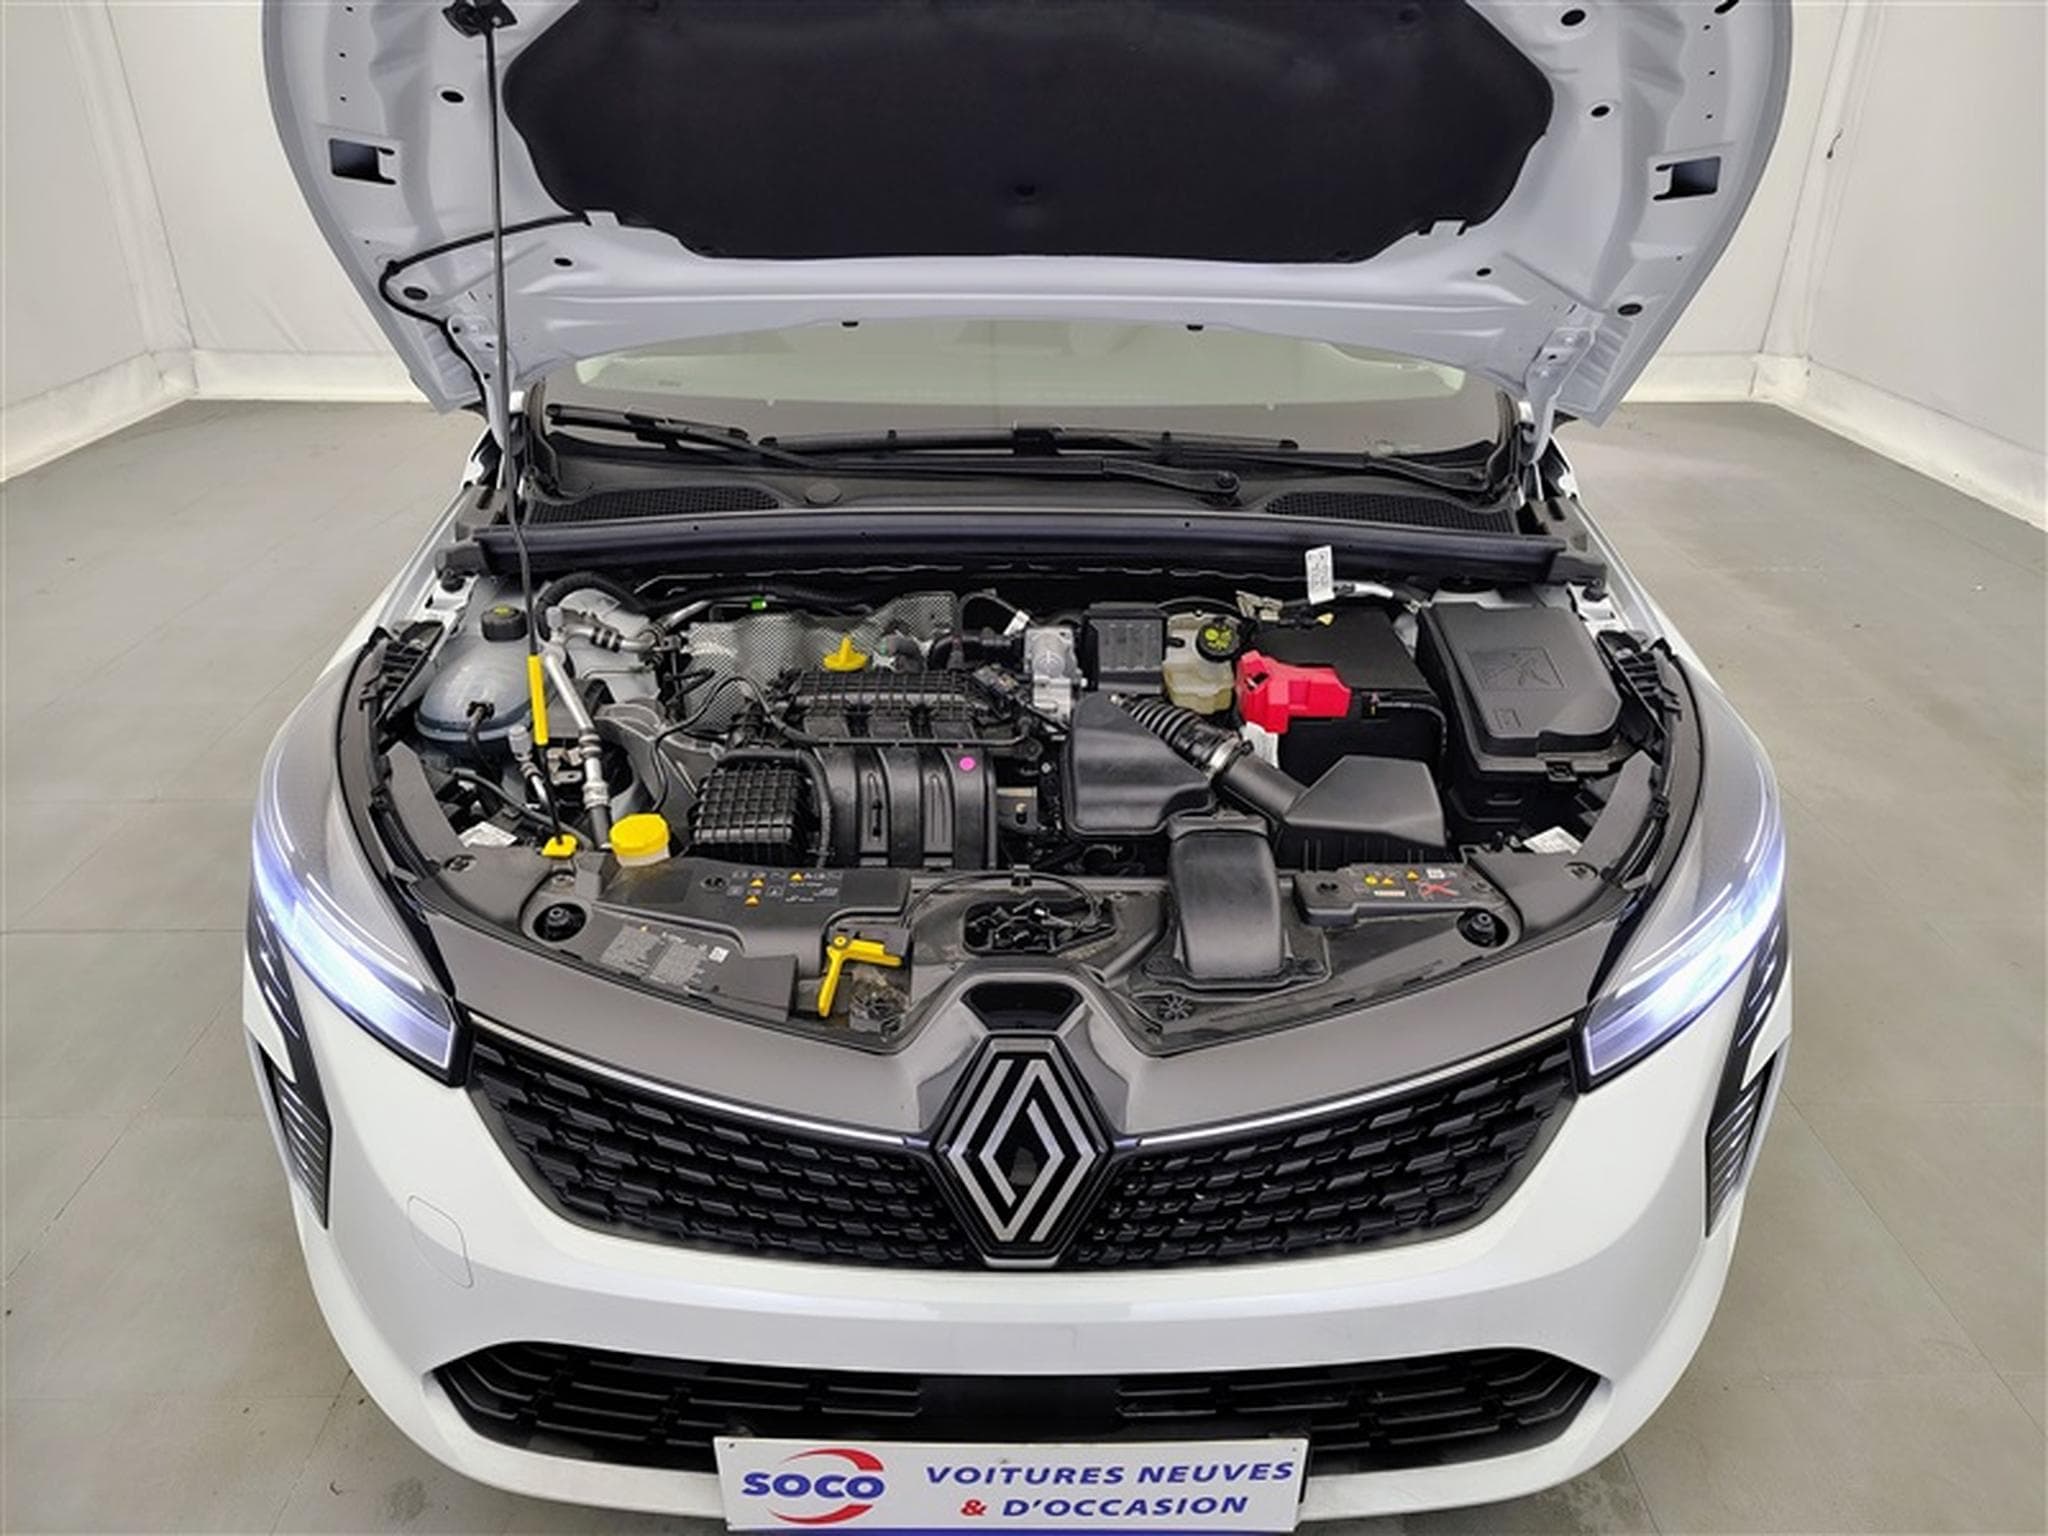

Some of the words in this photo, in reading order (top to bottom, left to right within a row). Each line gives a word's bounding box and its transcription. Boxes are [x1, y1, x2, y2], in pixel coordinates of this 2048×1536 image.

[742, 1471, 886, 1500] SOCO
[926, 1465, 1124, 1487] VOITURES
[1137, 1461, 1294, 1484] NEUVES
[961, 1499, 987, 1516] &
[1002, 1495, 1249, 1517] D'OCCASION
